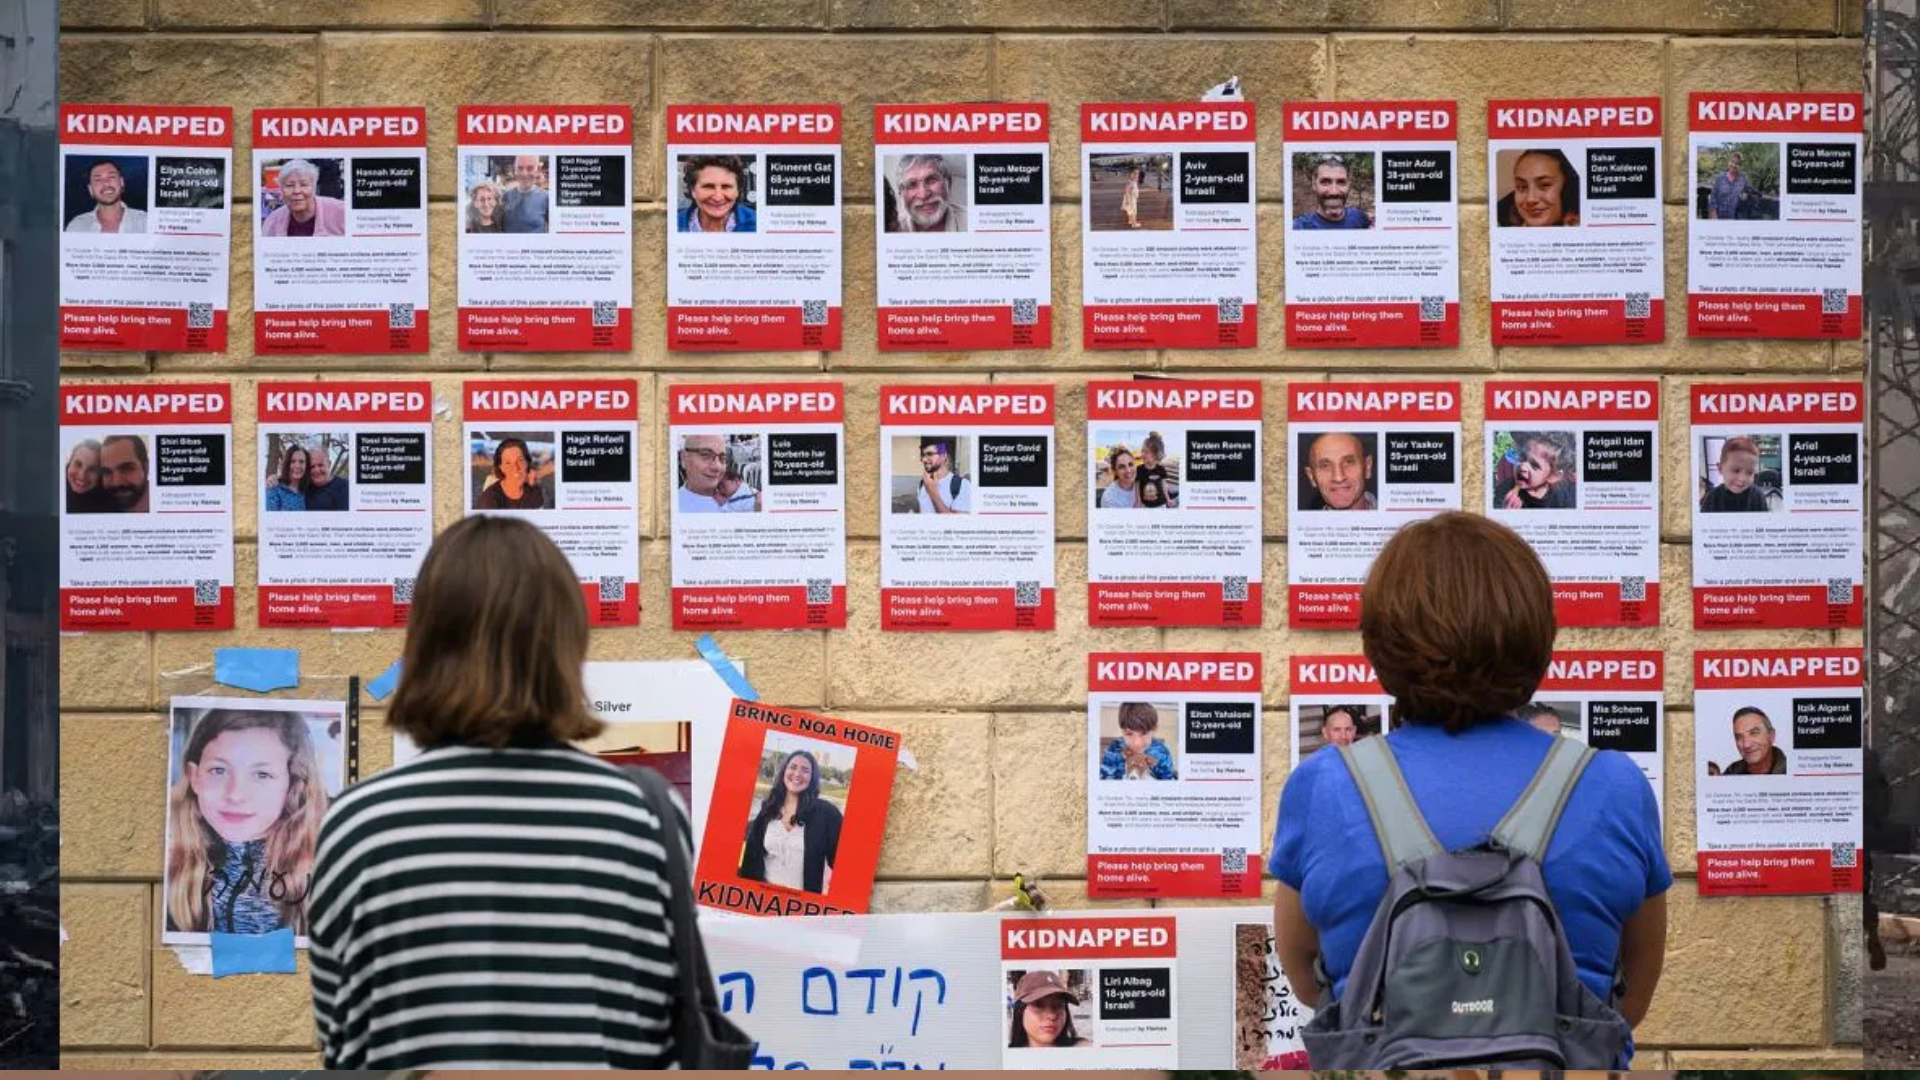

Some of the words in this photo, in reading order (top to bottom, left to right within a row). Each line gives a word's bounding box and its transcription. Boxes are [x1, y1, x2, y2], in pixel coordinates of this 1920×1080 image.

[1293, 111, 1449, 130] KIDNAPPED
[1498, 107, 1653, 127] KIDNAPPED
[1699, 102, 1855, 121] KIDNAPPED
[68, 115, 225, 135] KIDNAPPED
[262, 117, 418, 136] KIDNAPPED
[467, 115, 624, 133] KIDNAPPED
[677, 114, 833, 132] KIDNAPPED
[885, 113, 1041, 132] KIDNAPPED
[1091, 112, 1247, 131] KIDNAPPED
[185, 166, 216, 176] Cohen
[771, 163, 812, 172] Kinneret
[814, 163, 831, 172] Gat
[160, 178, 219, 187] 27-years-old
[770, 175, 830, 185] 68-years-old
[1185, 175, 1244, 184] 2-years-old
[160, 189, 188, 198] Israeli
[1185, 187, 1215, 195] Israeli
[468, 315, 498, 323] Please
[502, 315, 522, 324] help
[524, 315, 549, 324] bring
[1534, 309, 1554, 317] help
[1558, 309, 1582, 318] bring
[67, 394, 223, 413] KIDNAPPED
[267, 392, 424, 411] KIDNAPPED
[472, 391, 629, 409] KIDNAPPED
[679, 392, 835, 413] KIDNAPPED
[890, 395, 1046, 414] KIDNAPPED
[1097, 390, 1254, 408] KIDNAPPED
[1297, 392, 1453, 410] KIDNAPPED
[1494, 391, 1650, 409] KIDNAPPED
[1700, 393, 1856, 412] KIDNAPPED
[566, 435, 590, 444] Hagit
[1588, 437, 1621, 448] Avigail
[1624, 437, 1644, 446] Idan
[1588, 449, 1642, 459] 3-years-old
[1794, 454, 1851, 464] 4-years-old
[716, 595, 736, 604] help
[739, 594, 763, 604] bring
[766, 594, 790, 602] them
[1098, 662, 1254, 680] KIDNAPPED
[1299, 664, 1377, 682] KIDNA
[1548, 661, 1655, 679] NAPPED
[1704, 657, 1859, 677] KIDNAPPED
[594, 701, 633, 712] Silver
[734, 704, 793, 728] BRING
[799, 718, 837, 736] NOA
[844, 728, 894, 750] HOME
[1593, 717, 1649, 726] 21-years-old
[1098, 862, 1128, 870] Please
[1131, 862, 1151, 871] help
[1154, 862, 1178, 872] bring
[1008, 928, 1168, 948] KIDNAPPED
[1104, 977, 1121, 986] Liri
[1123, 977, 1152, 987] Albag
[802, 966, 946, 1036] קודם
[1105, 990, 1165, 999] 18-years-old
[1452, 1000, 1494, 1013] OUTDOOR
